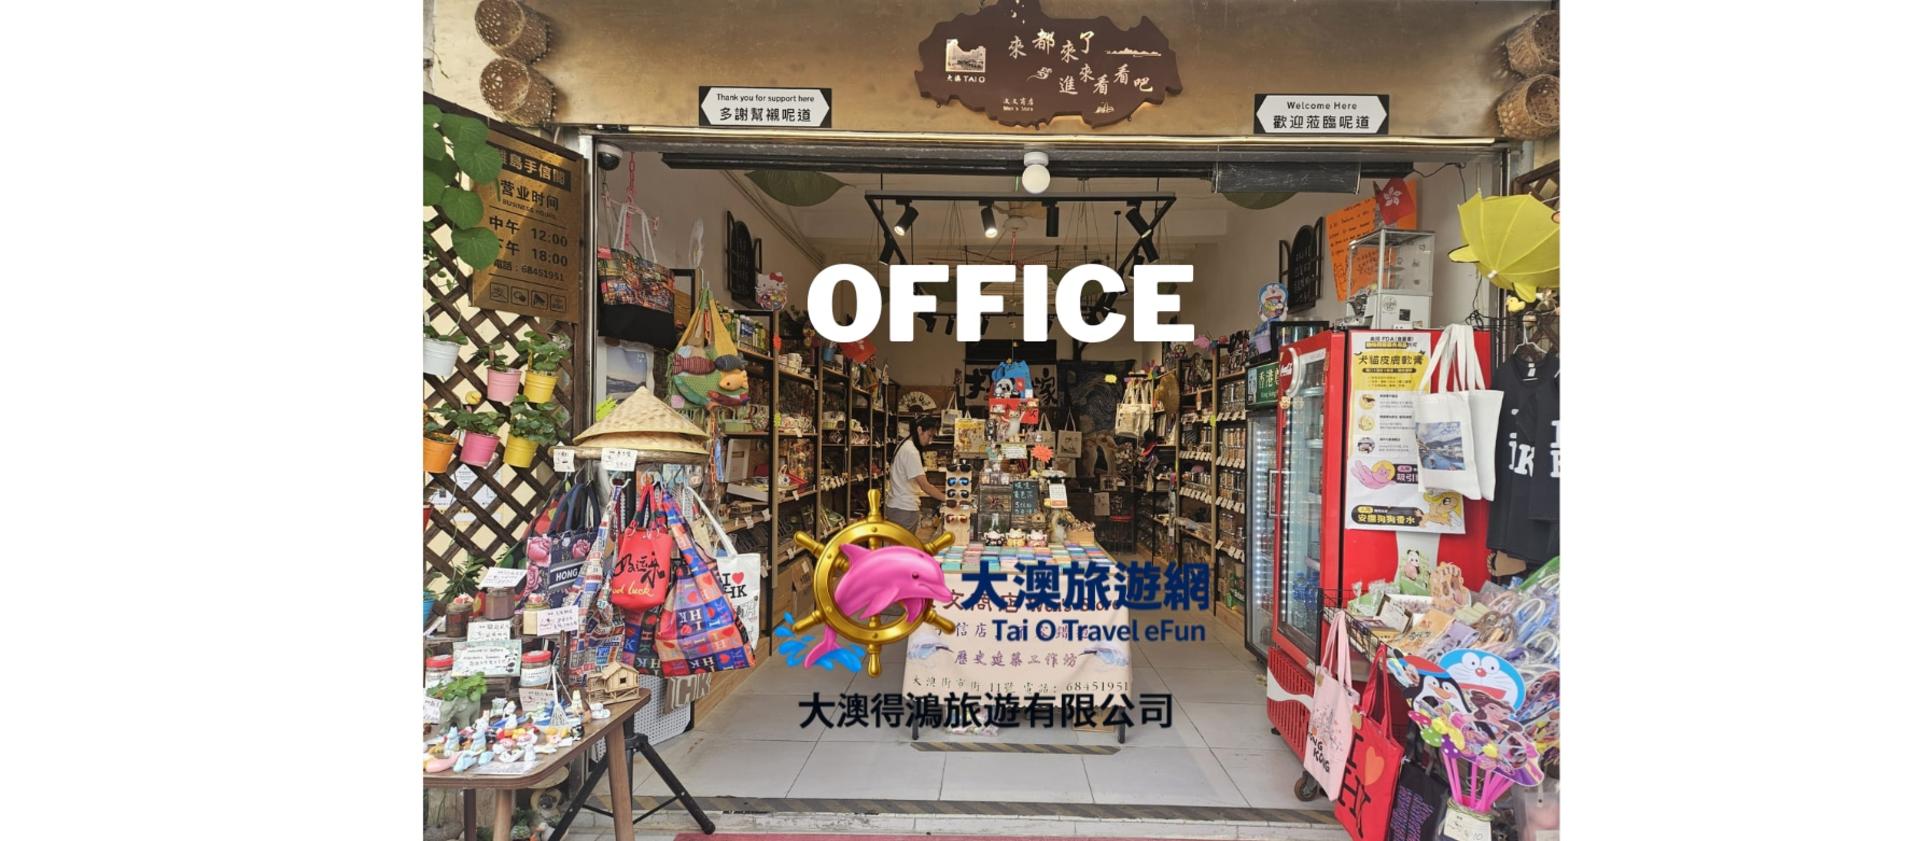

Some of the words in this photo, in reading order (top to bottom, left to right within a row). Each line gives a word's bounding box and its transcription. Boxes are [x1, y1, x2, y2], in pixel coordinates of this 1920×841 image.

[717, 93, 739, 101] Thank
[740, 95, 754, 103] you
[767, 95, 797, 103] support
[1286, 101, 1331, 110] Welcome
[1333, 101, 1358, 110] Here
[500, 180, 559, 211] 营业时间
[489, 215, 520, 235] 中午
[531, 228, 568, 248] 12:00
[532, 248, 568, 267] 18:00
[556, 567, 578, 582] HONG
